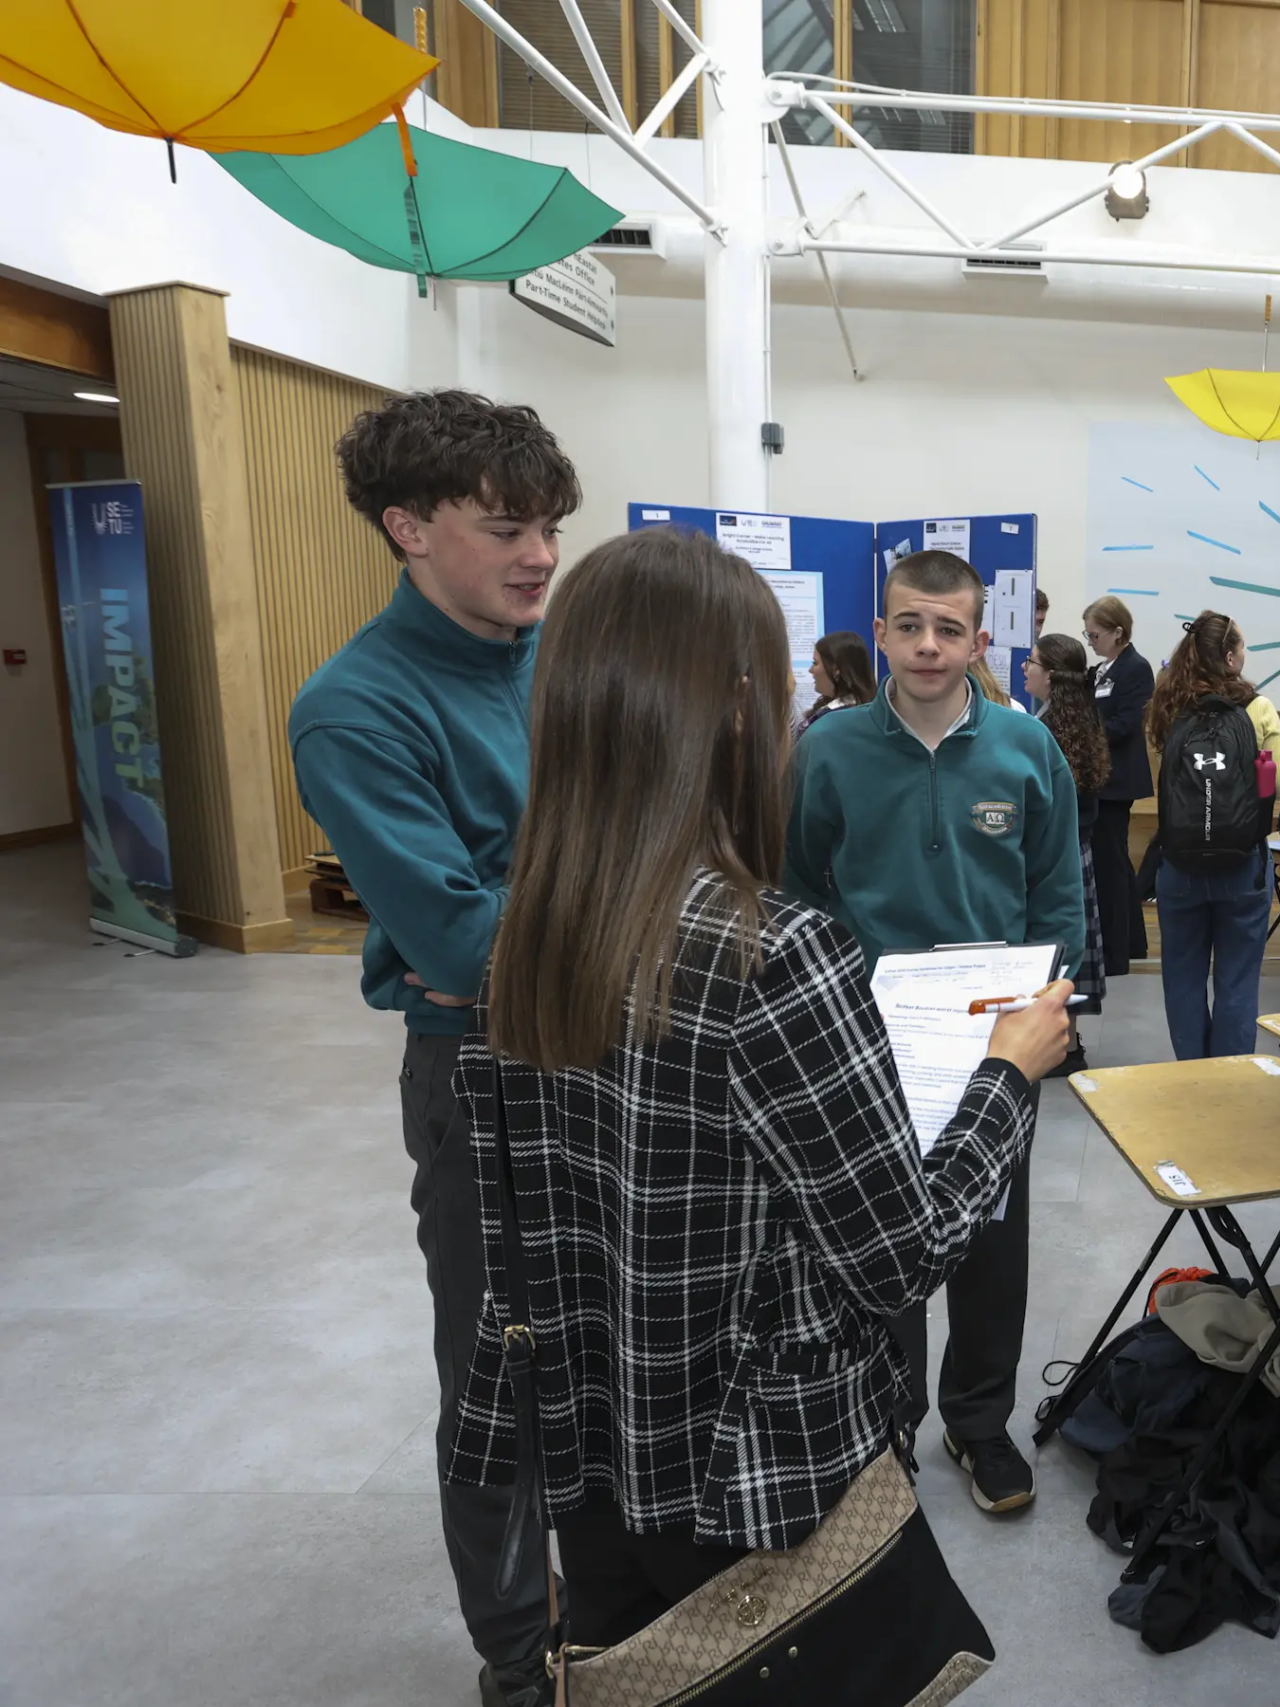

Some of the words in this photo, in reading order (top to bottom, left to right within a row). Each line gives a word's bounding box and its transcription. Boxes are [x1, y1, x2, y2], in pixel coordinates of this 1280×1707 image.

[575, 266, 595, 286] Office
[525, 278, 561, 303] Part-Time
[563, 296, 586, 317] Student
[107, 501, 121, 517] SE
[109, 518, 122, 534] TU
[100, 588, 144, 788] IMPACT
